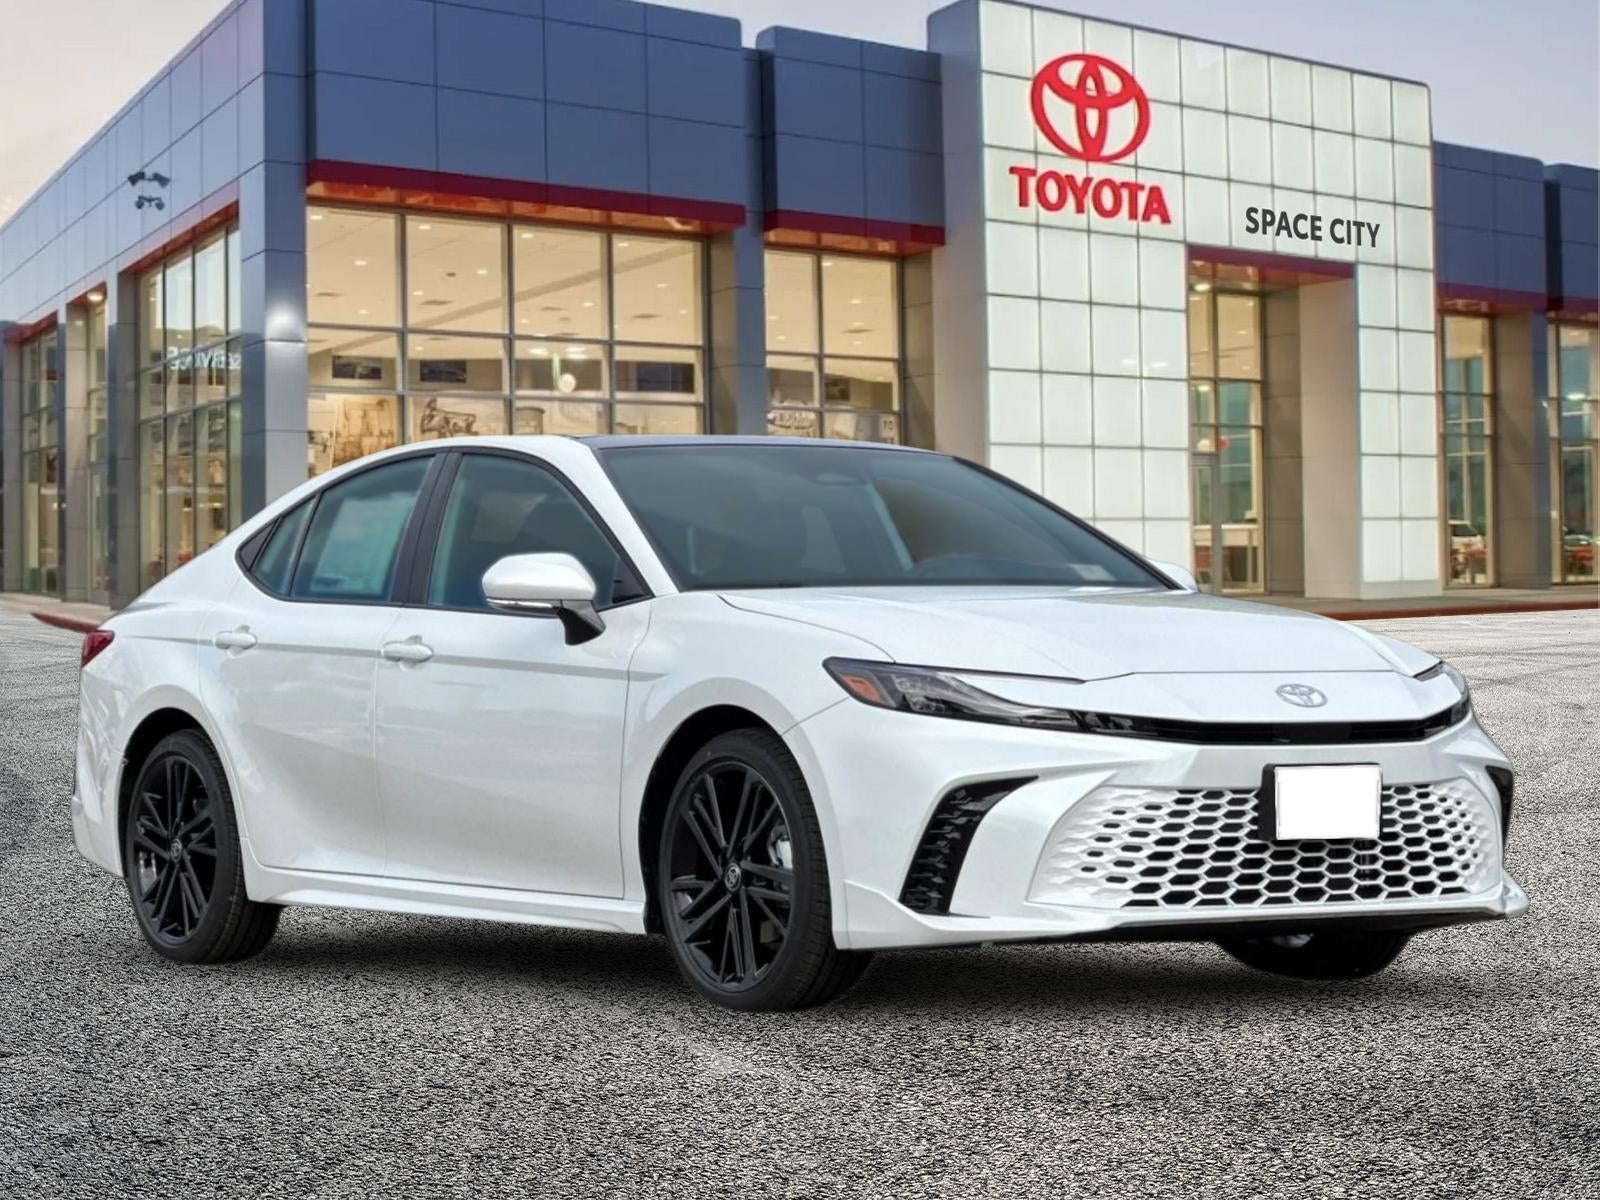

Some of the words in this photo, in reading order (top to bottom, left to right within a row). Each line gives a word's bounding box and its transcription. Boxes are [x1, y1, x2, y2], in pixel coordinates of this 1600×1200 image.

[1009, 166, 1171, 224] TOYOTA
[1246, 206, 1322, 242] SPACE
[1329, 217, 1380, 248] CITY
